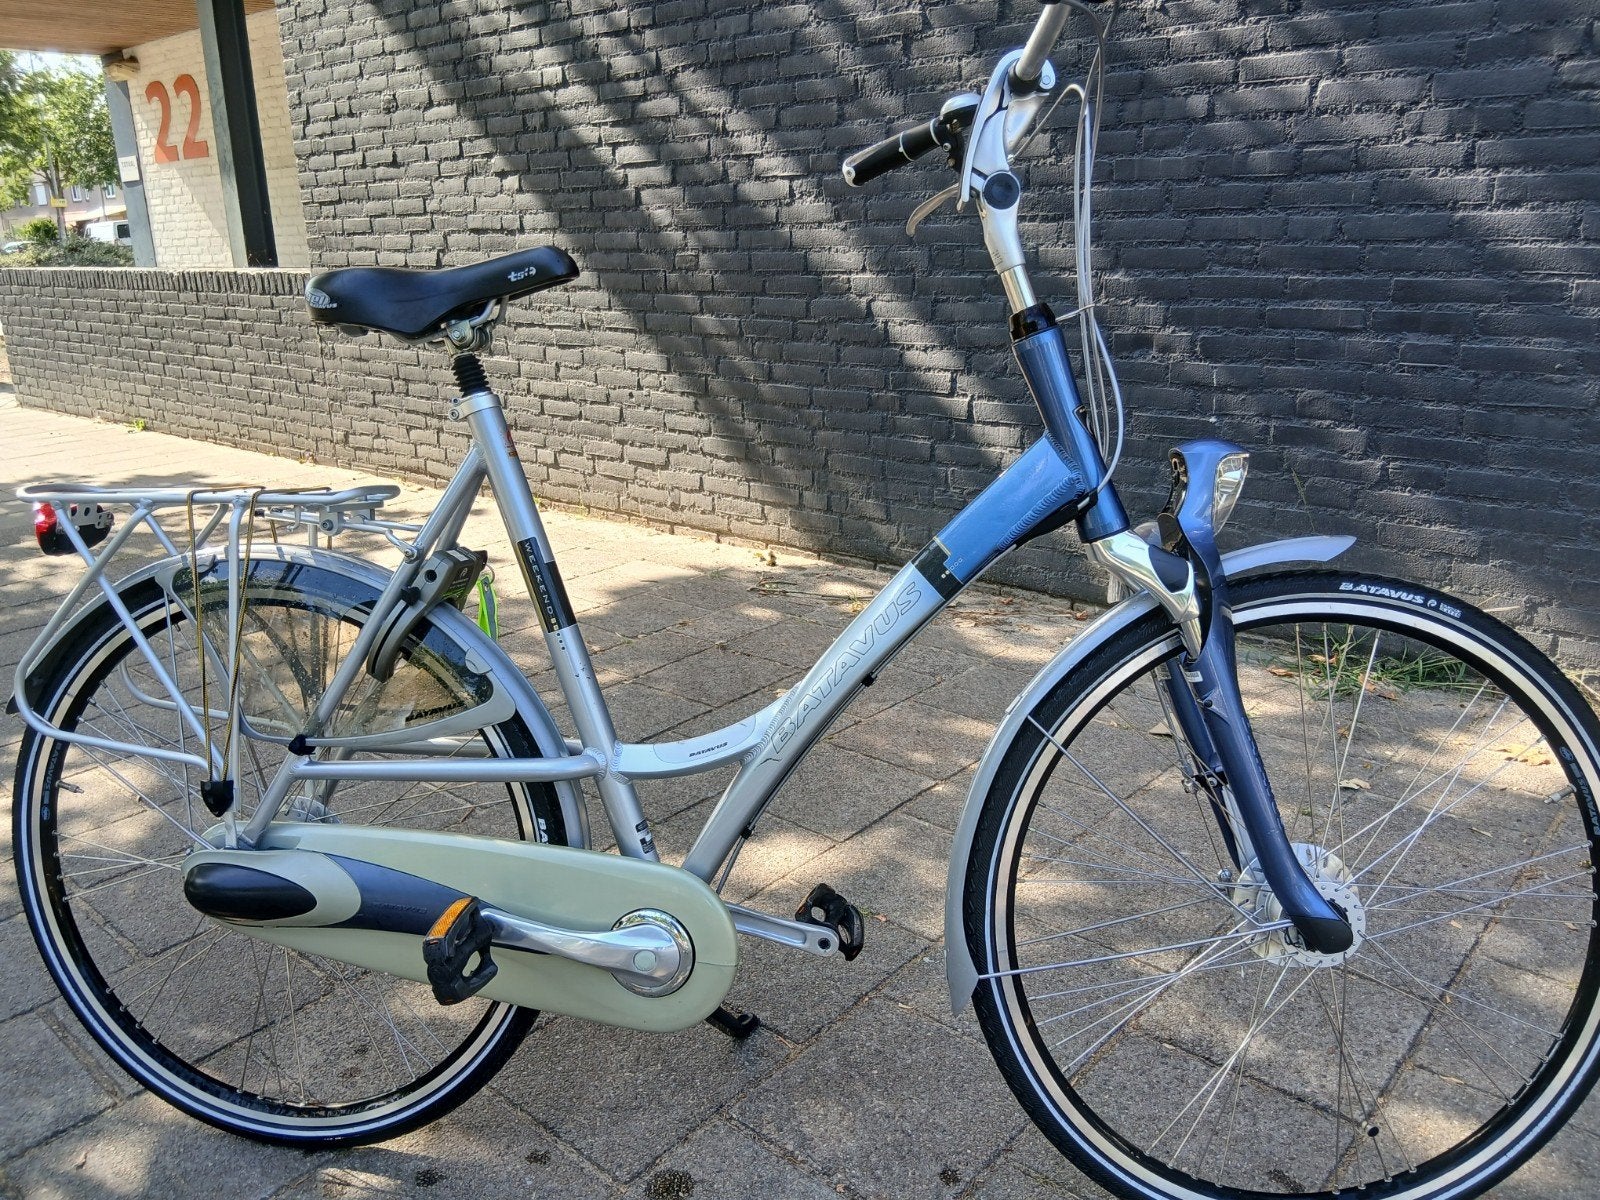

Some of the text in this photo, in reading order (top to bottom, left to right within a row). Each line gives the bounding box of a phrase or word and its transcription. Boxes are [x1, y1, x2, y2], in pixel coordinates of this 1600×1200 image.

[145, 74, 209, 164] 22
[525, 542, 554, 615] WEEKEND
[1339, 581, 1425, 604] BATAVUS
[770, 581, 922, 755] BATAVUS
